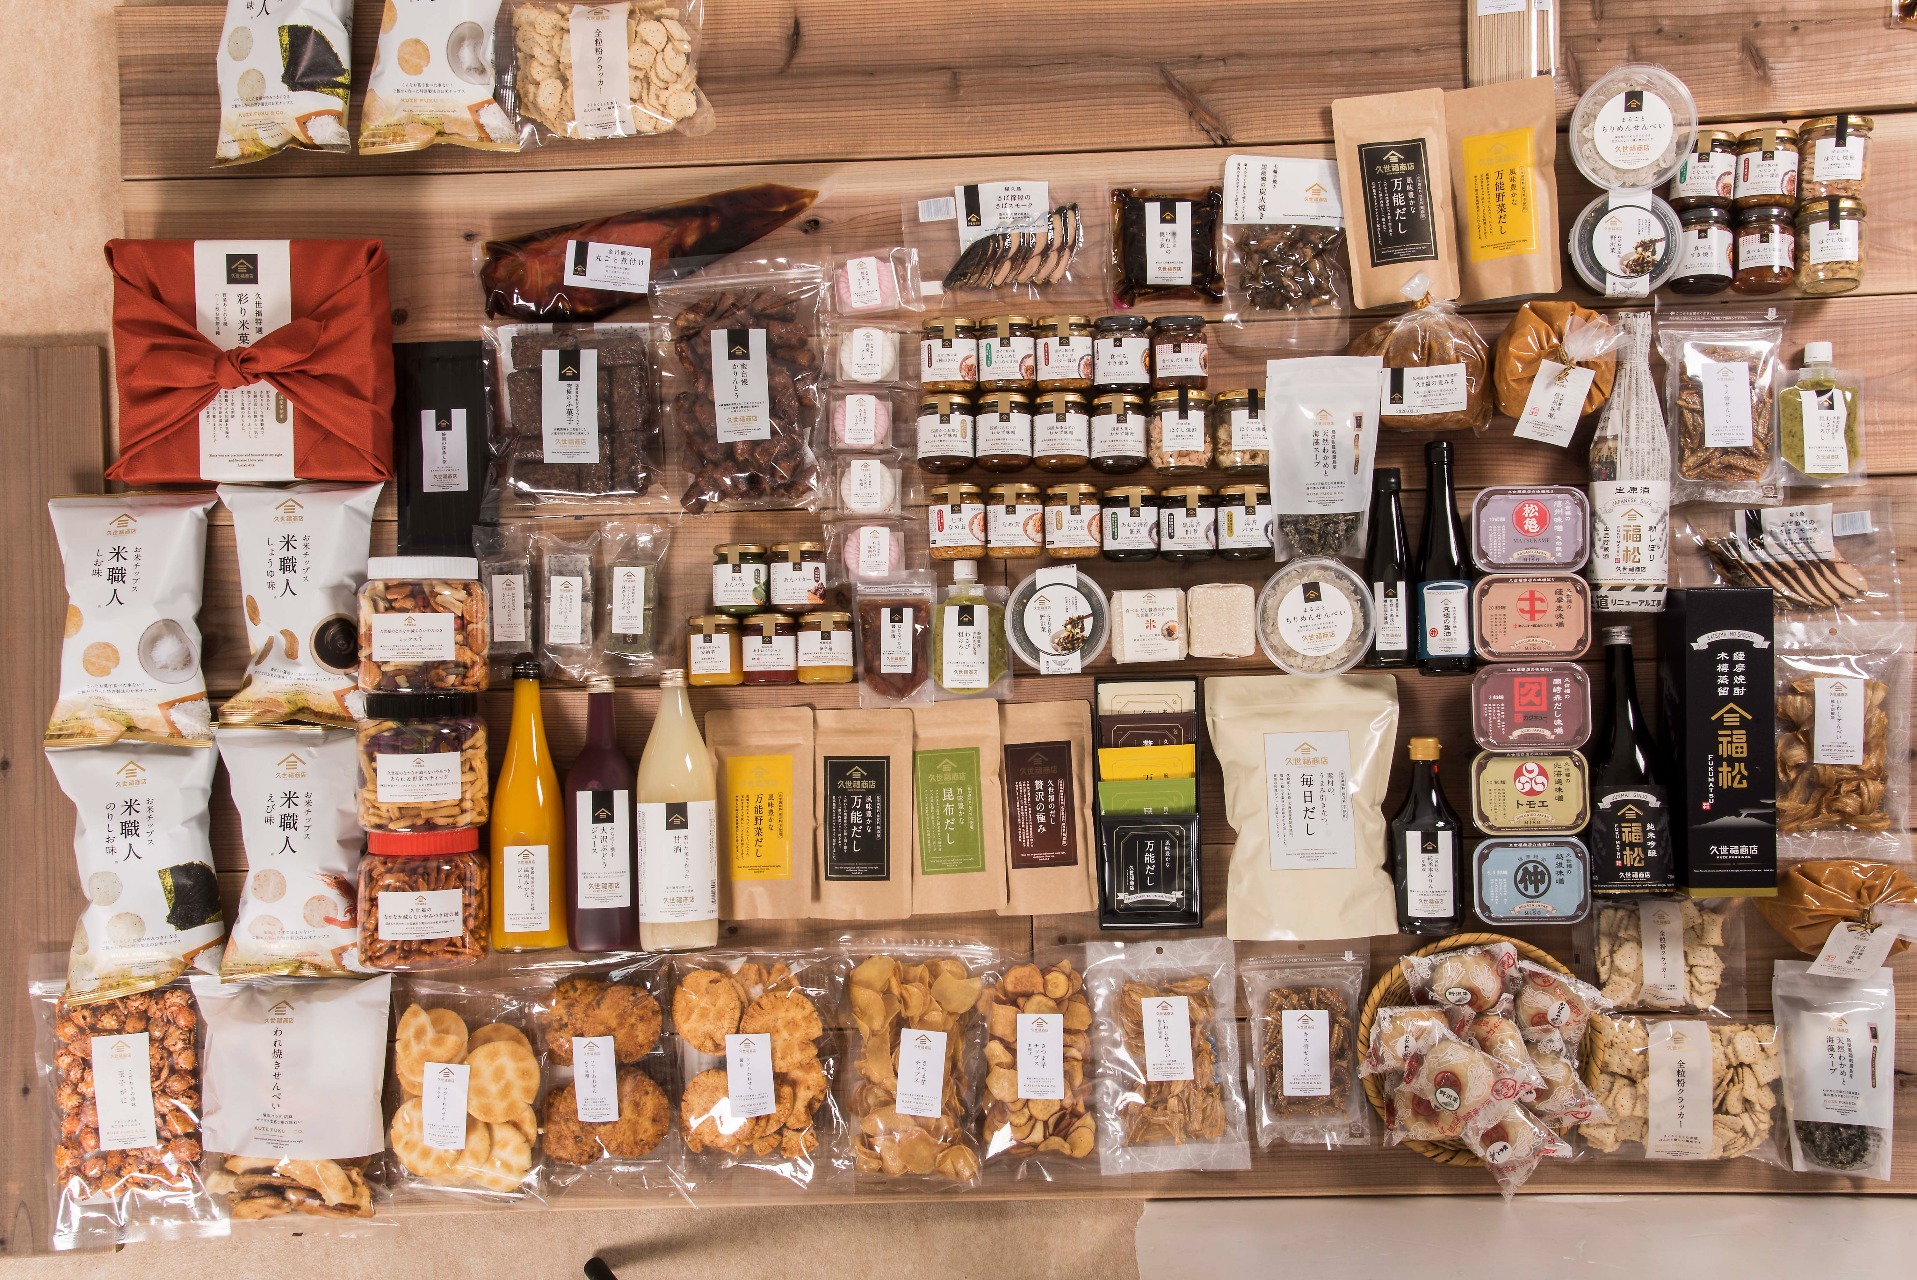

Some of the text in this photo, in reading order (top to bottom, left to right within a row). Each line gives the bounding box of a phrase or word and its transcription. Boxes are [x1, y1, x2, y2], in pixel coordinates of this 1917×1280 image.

[594, 29, 604, 94] 全粒粉クラッカー
[1601, 123, 1666, 133] ちりめんせんべい
[1375, 162, 1415, 175] 久世福商店
[1391, 178, 1406, 234] 万能だし
[1404, 176, 1414, 214] 風味豊かな
[1494, 169, 1506, 235] 万能野菜だし
[595, 254, 645, 266] 丸ごと煮付け
[237, 293, 250, 344] 彩り米菓
[254, 293, 263, 334] 久世福特選
[1312, 429, 1320, 468] 海藻スープ
[1322, 429, 1330, 476] 天然わかめと
[1521, 503, 1541, 533] 松亀
[1553, 500, 1564, 532] 信州味噌
[92, 549, 103, 577] しお味
[266, 537, 276, 591] しょうゆ味
[279, 534, 298, 597] 米職人
[302, 534, 311, 582] お米チップス
[1622, 524, 1642, 564] 福松
[105, 545, 128, 607] 米職人
[132, 547, 142, 592] お米チップス
[1611, 599, 1663, 608] リニューアル工事
[1716, 651, 1729, 696] 木樽蒸留
[1732, 651, 1746, 696] 薩摩焼酎
[1284, 757, 1329, 766] 久世福商店
[1553, 762, 1563, 802] 北海道味噌
[1707, 754, 1715, 804] FUKUMATSU
[1717, 729, 1748, 790] 福松
[837, 780, 876, 789] 久世福商店
[1034, 779, 1047, 834] 贅沢の極み
[1047, 779, 1056, 825] 久世福のだし
[1300, 773, 1316, 836] 毎日だし
[1515, 799, 1549, 810] トモエ
[105, 802, 117, 855] のりしお味
[119, 799, 142, 862] 米職人
[145, 798, 155, 845] お米チップス
[264, 793, 275, 825] えび味
[278, 790, 299, 854] 米職人
[303, 791, 313, 839] お米チップス
[753, 793, 763, 858] 万能野菜だし
[850, 795, 863, 852] 万能だし
[942, 787, 956, 845] 昆布だし
[673, 835, 681, 853] 甘酒
[1621, 822, 1645, 867] 福松
[1646, 822, 1658, 857] 純米吟醸
[1709, 844, 1758, 854] 久世福商店
[1144, 840, 1155, 886] 万能だし
[1518, 864, 1546, 893] 仲
[1554, 853, 1565, 885] 越後味噌
[1619, 871, 1651, 879] 久世福商店
[1659, 930, 1667, 979] 全粒粉クラッカー
[1447, 990, 1469, 998] 野沢菜
[272, 1027, 283, 1110] われ焼きせんべい
[1825, 1035, 1838, 1074] 海藻スープ
[1835, 1036, 1847, 1086] 天然わかめと
[1676, 1059, 1686, 1129] 全粒粉クラッカー
